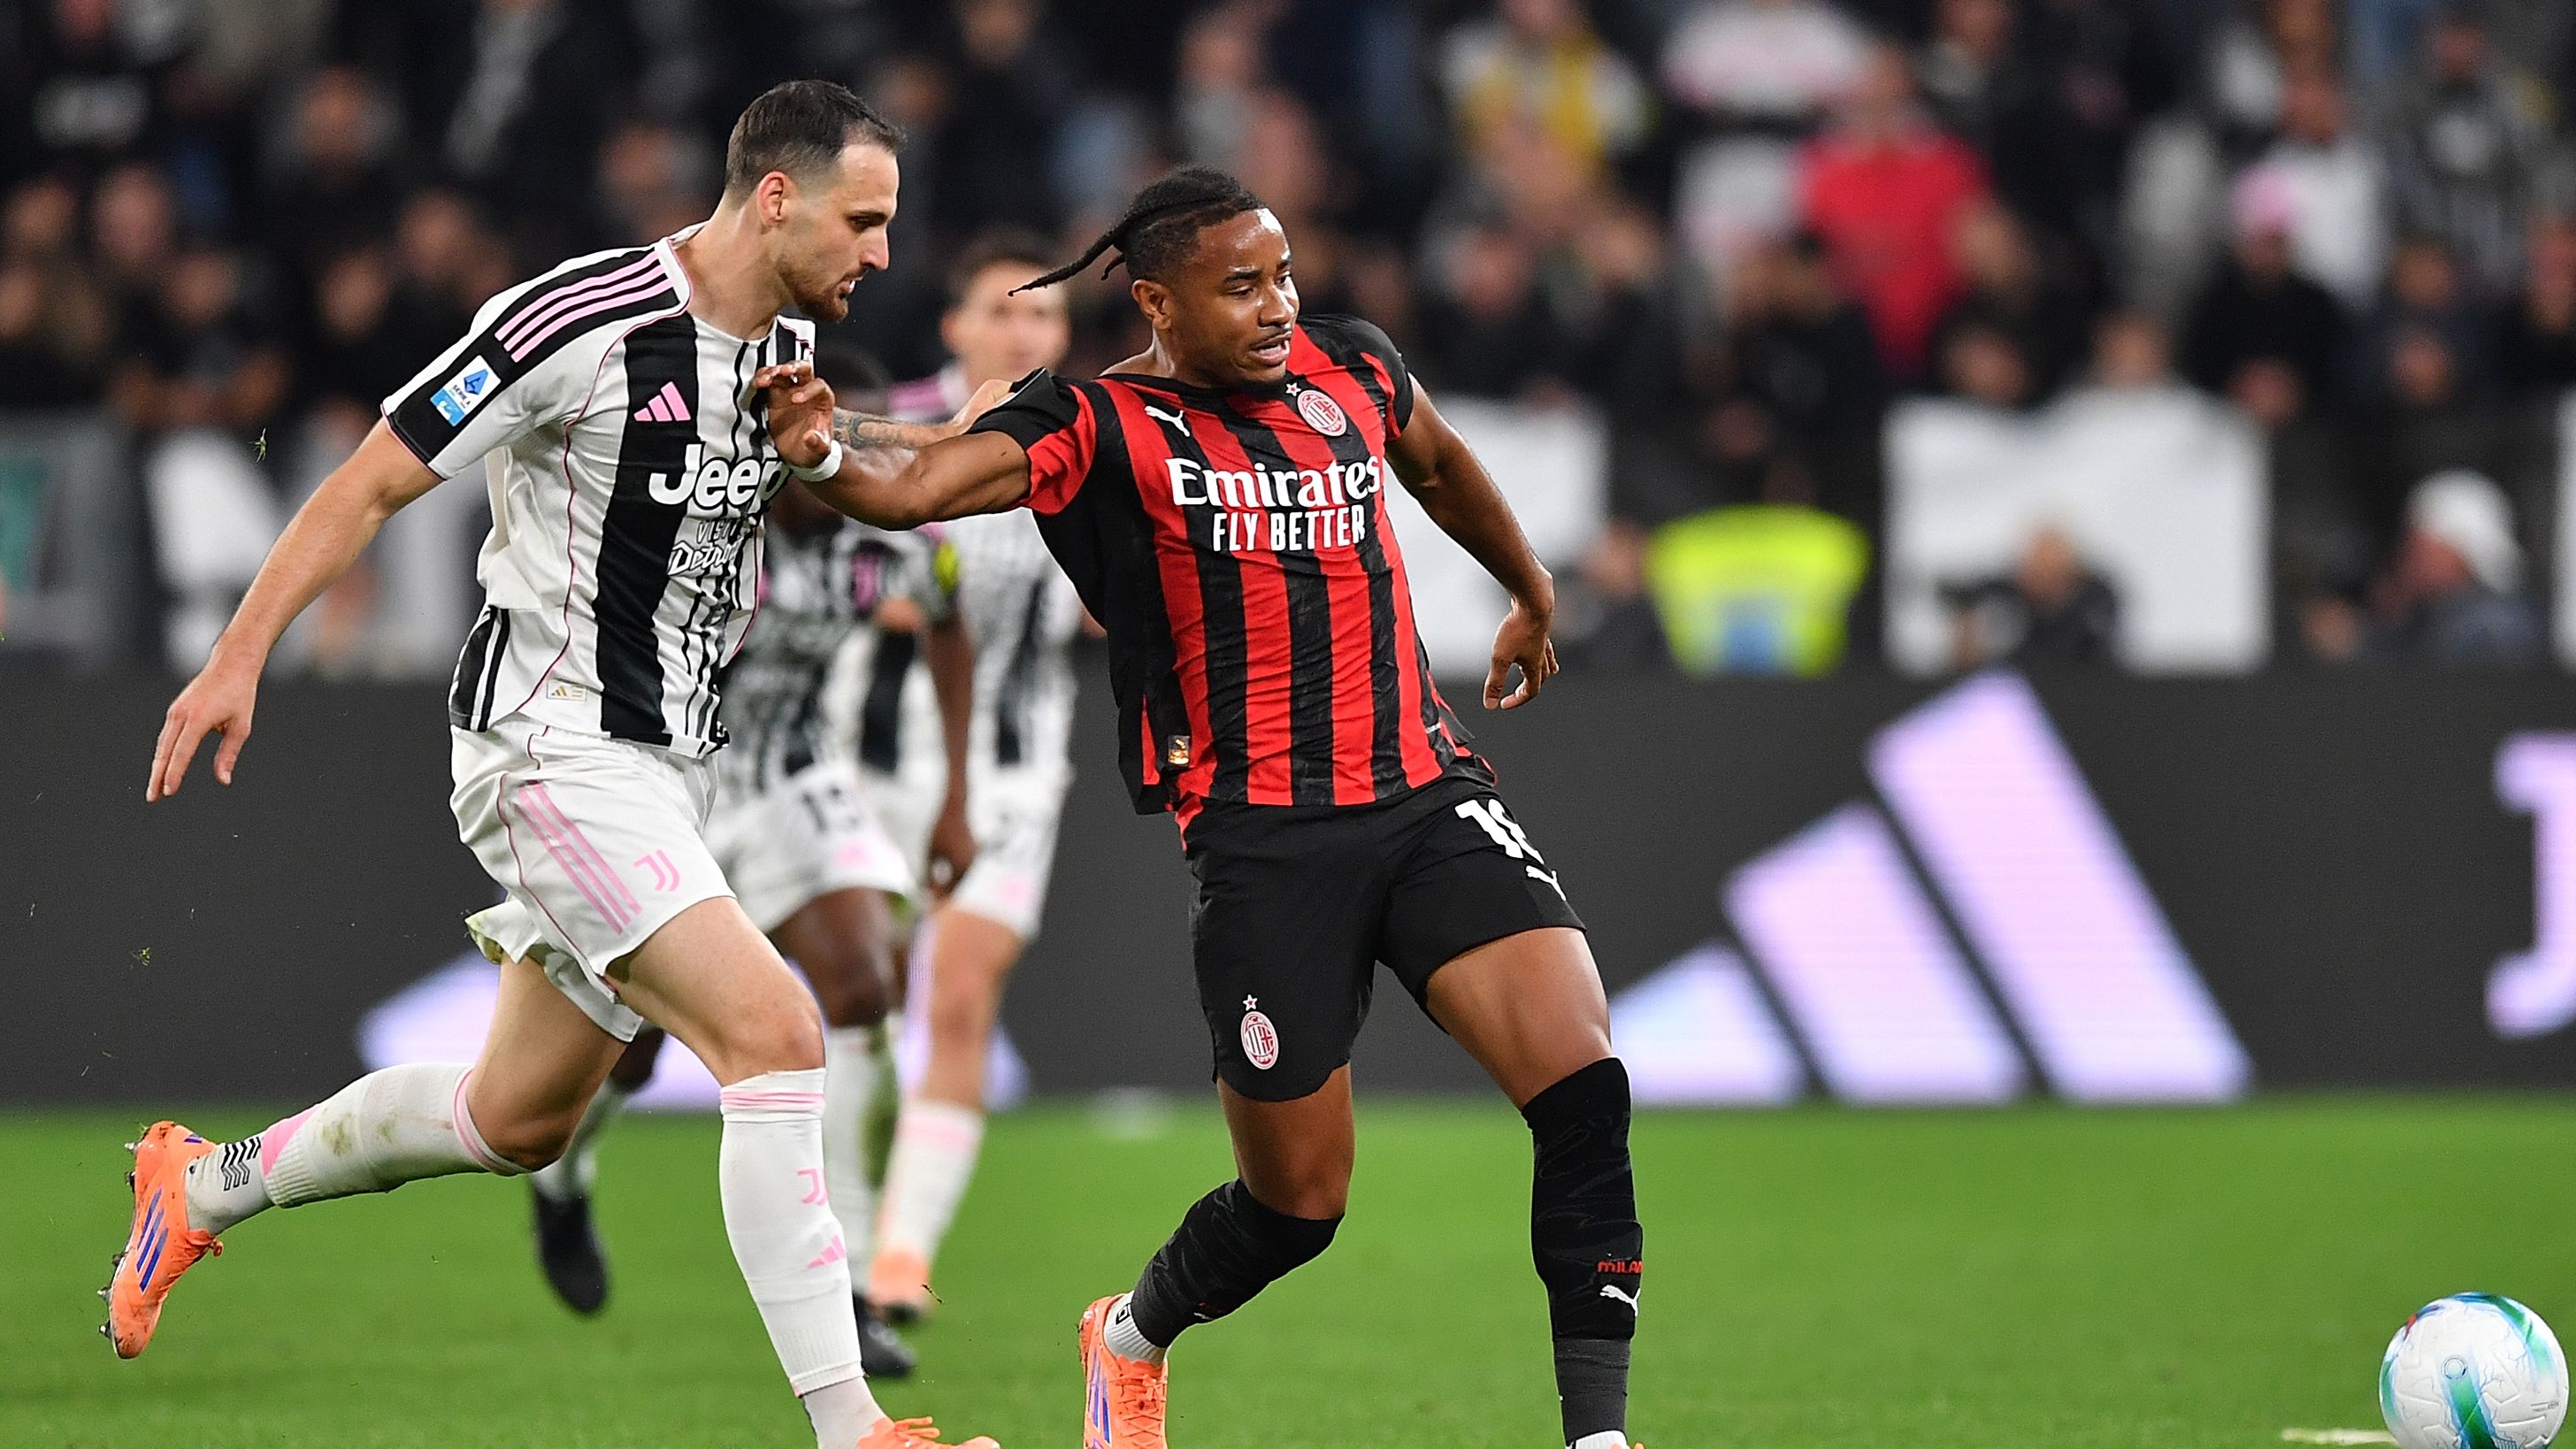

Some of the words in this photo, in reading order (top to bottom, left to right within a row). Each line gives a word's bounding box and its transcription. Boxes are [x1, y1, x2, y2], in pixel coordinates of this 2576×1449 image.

[648, 443, 790, 514] Jeep
[1165, 456, 1380, 508] Emirates
[1213, 511, 1259, 551] FLY
[1270, 504, 1366, 551] BETTER
